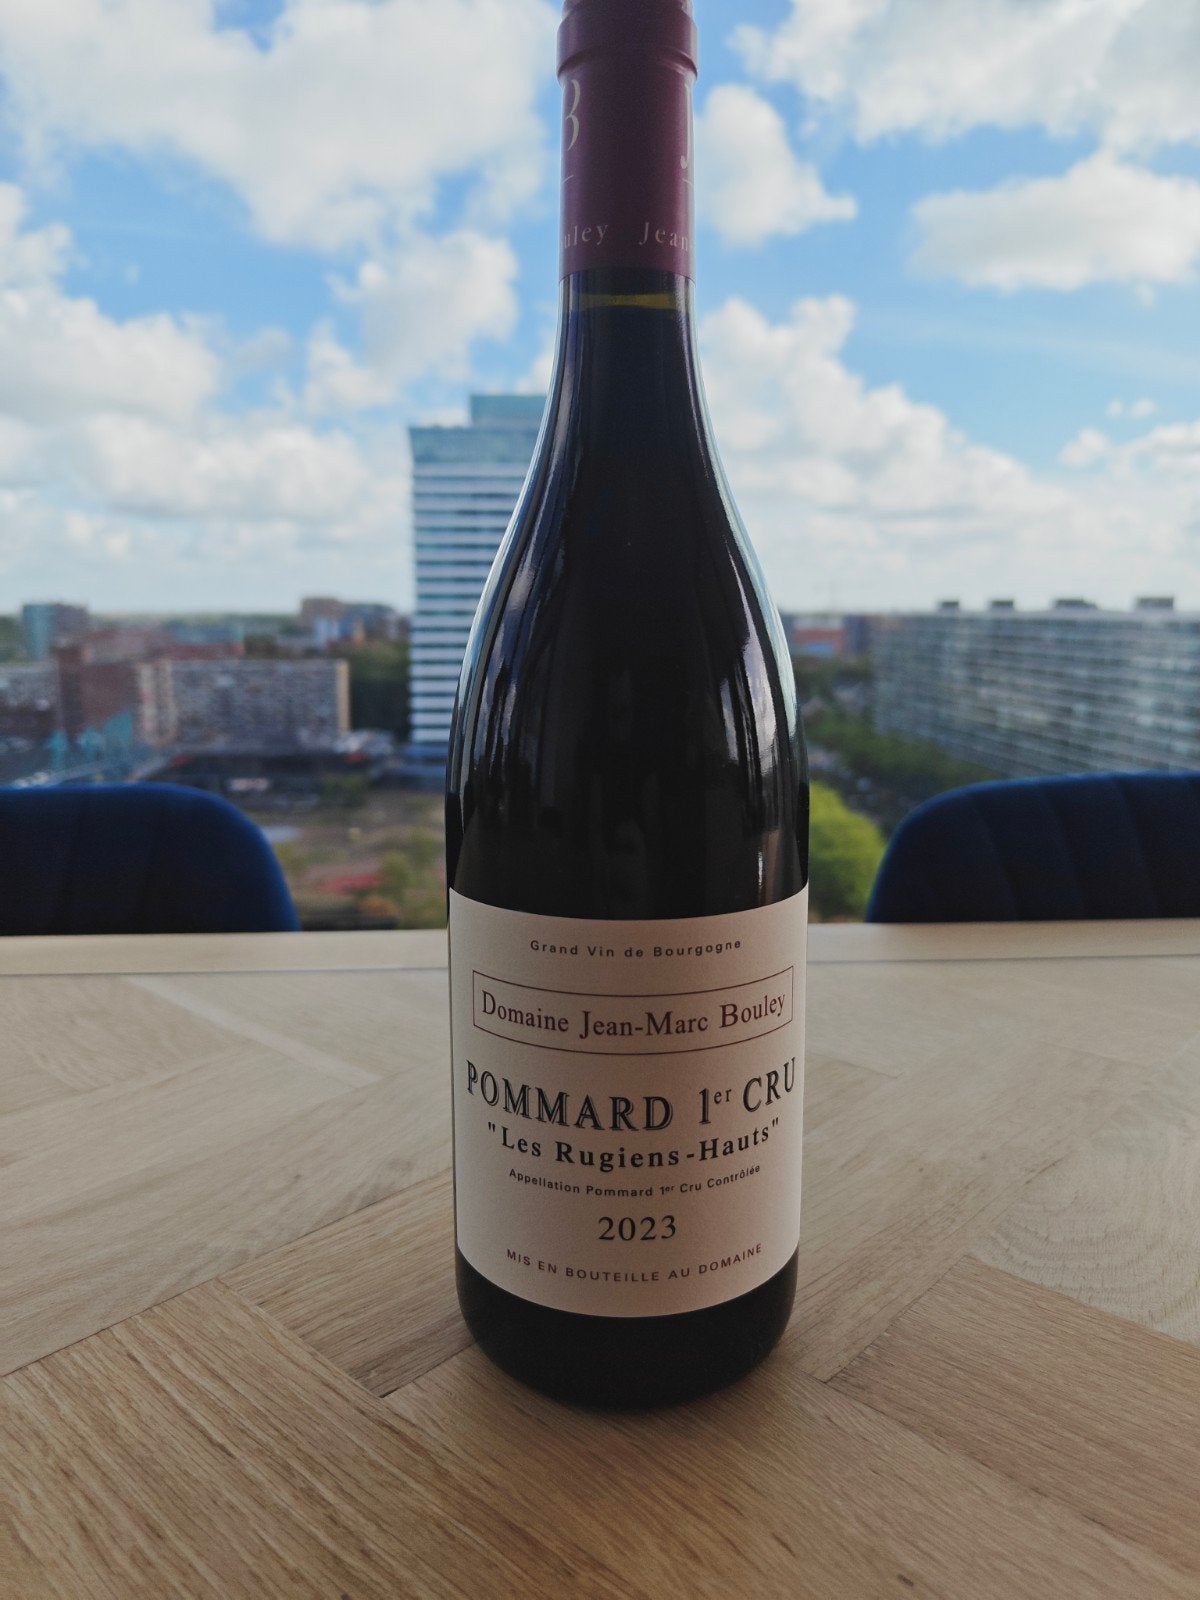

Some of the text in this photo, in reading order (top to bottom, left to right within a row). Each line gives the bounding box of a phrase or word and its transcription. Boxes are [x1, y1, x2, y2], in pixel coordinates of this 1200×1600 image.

[562, 224, 608, 250] uley
[530, 940, 742, 958] Grand Vin de Bourgogne
[482, 990, 786, 1039] Domaine Jean-Marc Bouley
[466, 1057, 796, 1131] POMMARD 1er CRU
[488, 1117, 779, 1172] "Les Rugiens-Hauts"
[509, 1164, 761, 1197] Appellation Pommard 1er Cru Contrôlée
[598, 1215, 677, 1241] 2023
[507, 1243, 762, 1282] MIS EN BOUTEILLE AU DOMAINE
